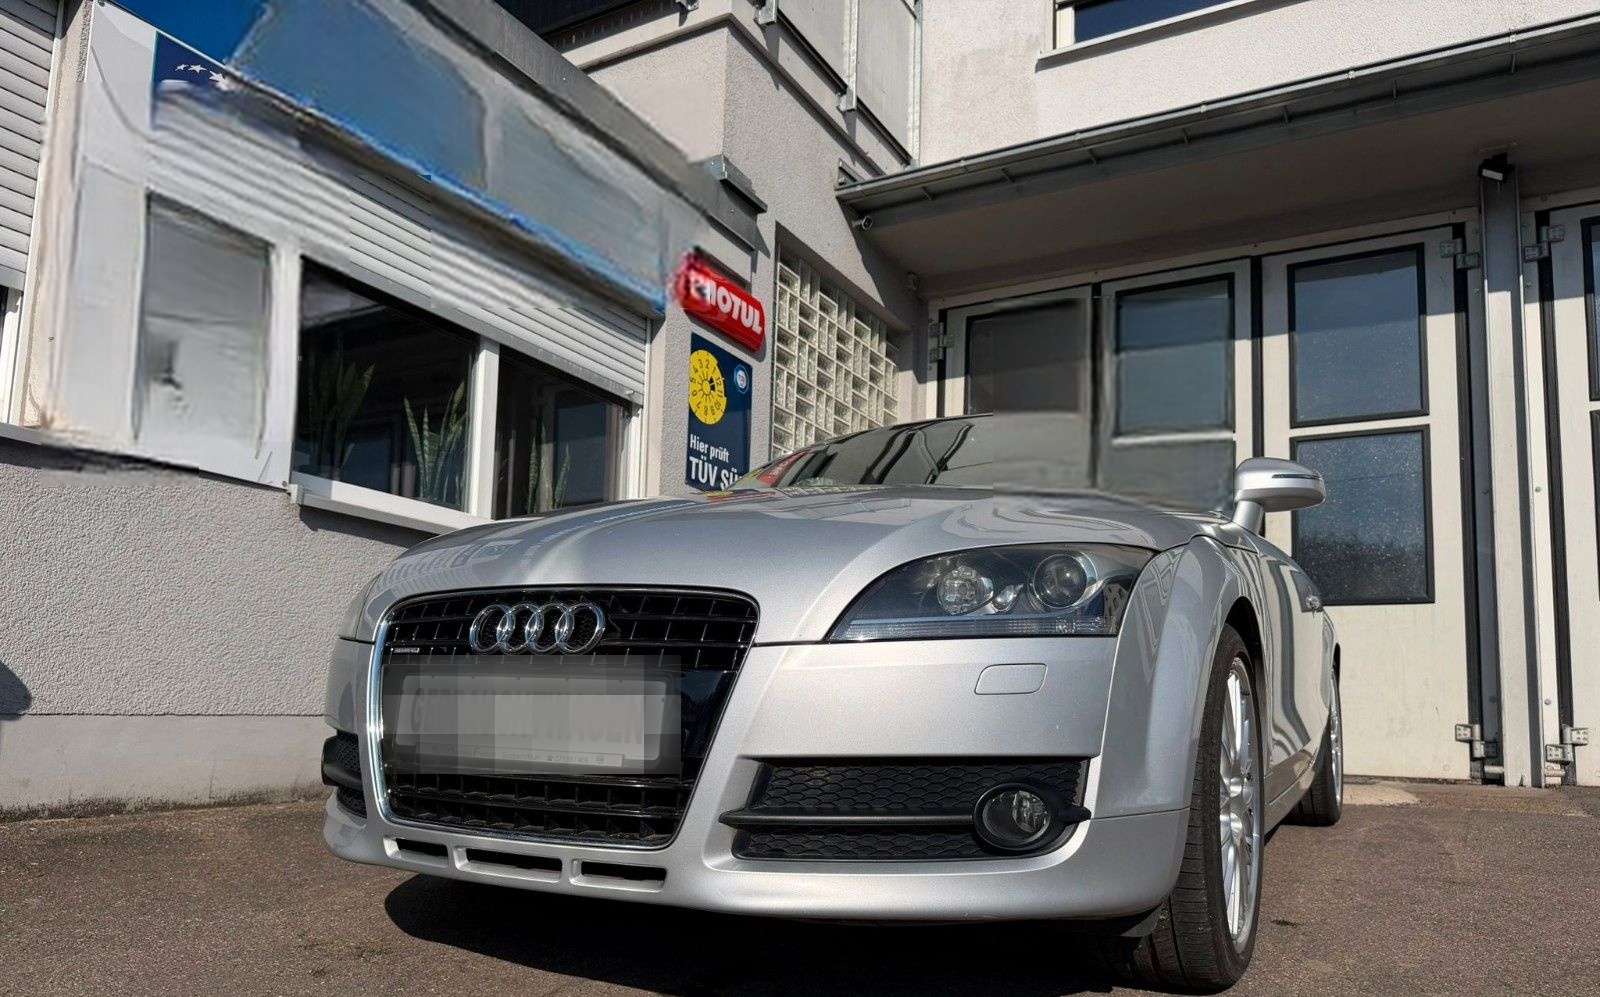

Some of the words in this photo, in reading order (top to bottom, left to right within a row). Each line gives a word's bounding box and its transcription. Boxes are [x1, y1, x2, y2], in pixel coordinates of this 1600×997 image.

[698, 358, 703, 369] 3
[705, 359, 710, 369] 2
[690, 433, 709, 454] Hier
[709, 446, 730, 463] prüft
[689, 455, 718, 487] TÜV
[720, 467, 743, 491] SÜ
